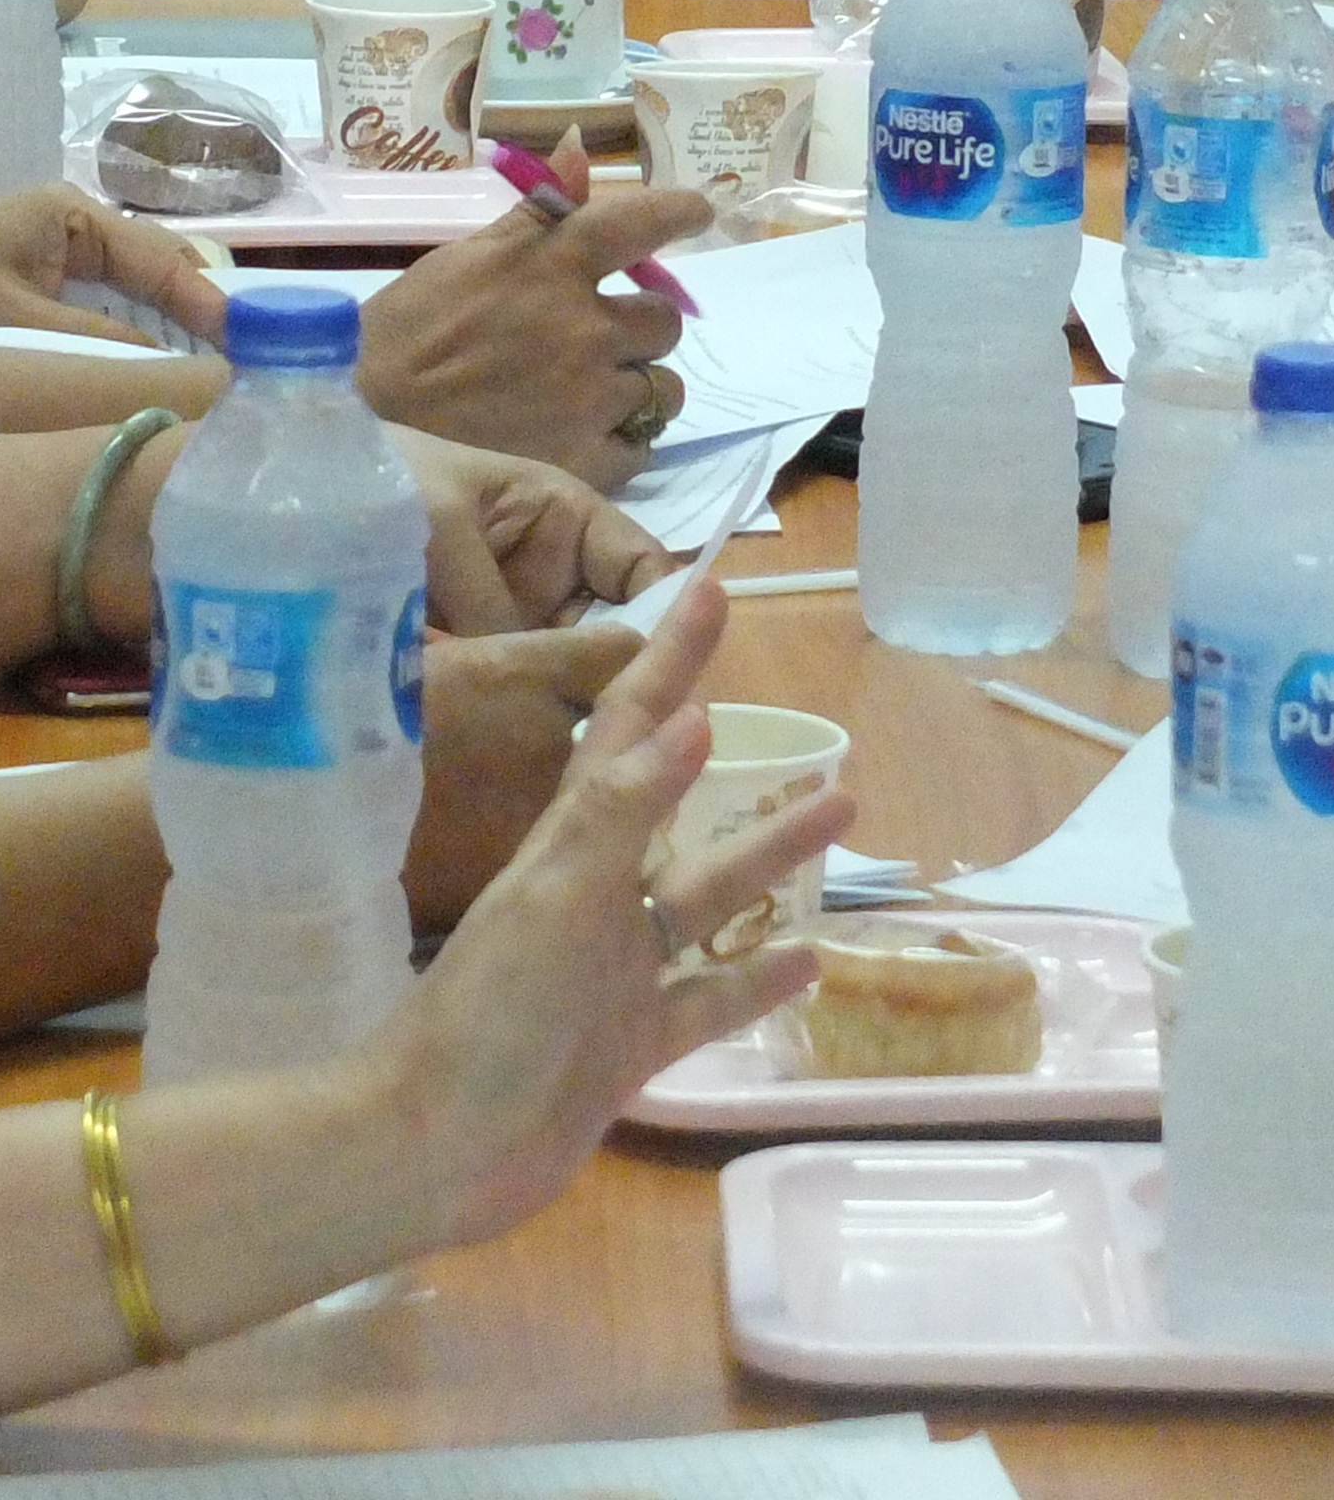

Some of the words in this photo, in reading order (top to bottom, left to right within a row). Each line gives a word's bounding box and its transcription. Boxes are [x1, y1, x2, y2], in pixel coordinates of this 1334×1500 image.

[340, 105, 459, 172] Coffee
[875, 124, 933, 164] Pure
[939, 137, 995, 179] Life
